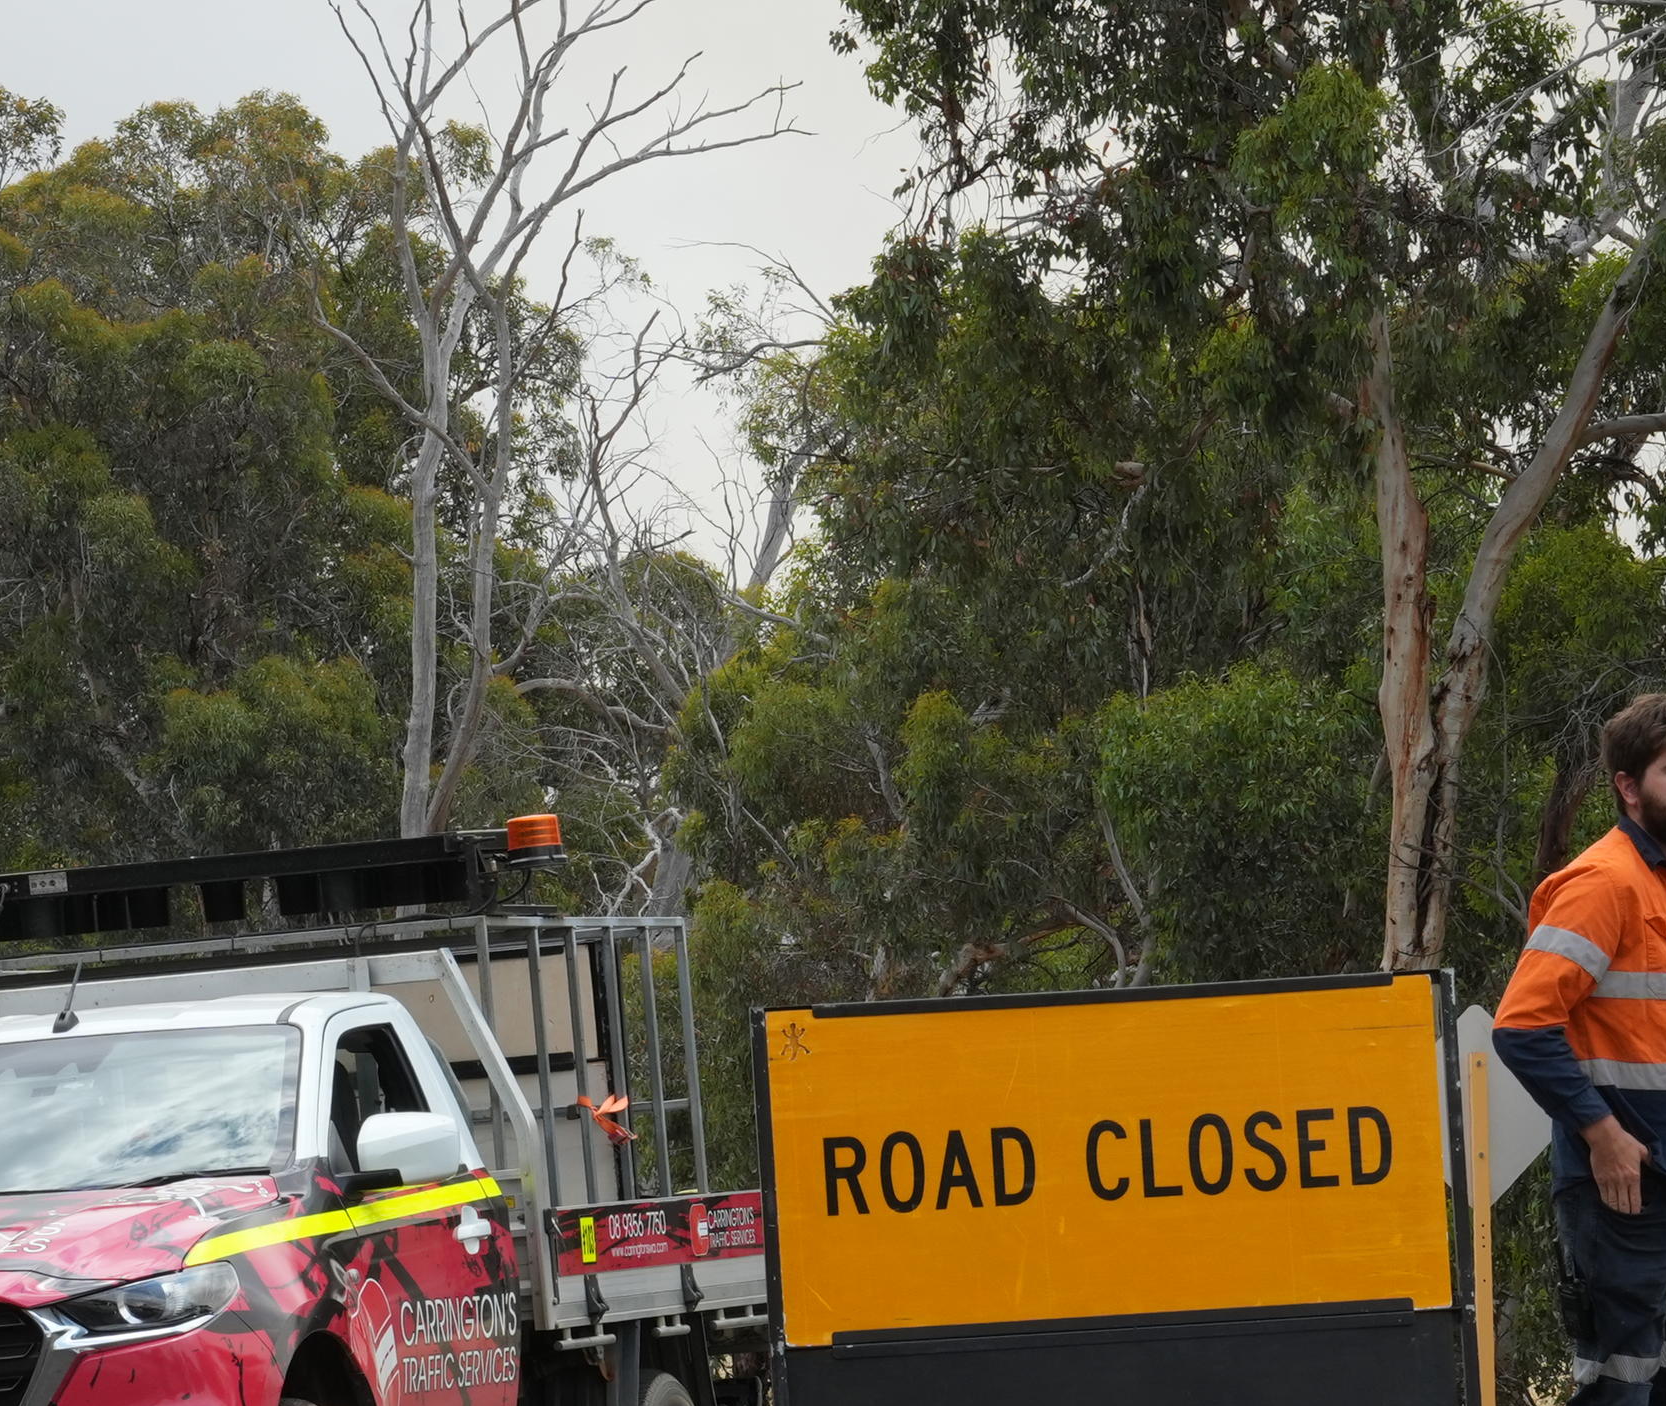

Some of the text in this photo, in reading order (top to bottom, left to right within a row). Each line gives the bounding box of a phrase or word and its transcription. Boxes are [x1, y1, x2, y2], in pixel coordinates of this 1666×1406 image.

[822, 1106, 1394, 1218] ROAD CLOSED
[608, 1214, 621, 1240] 08
[400, 1292, 517, 1346] CARRINGTON'S
[403, 1346, 517, 1393] TRAFFIC SERVICES
